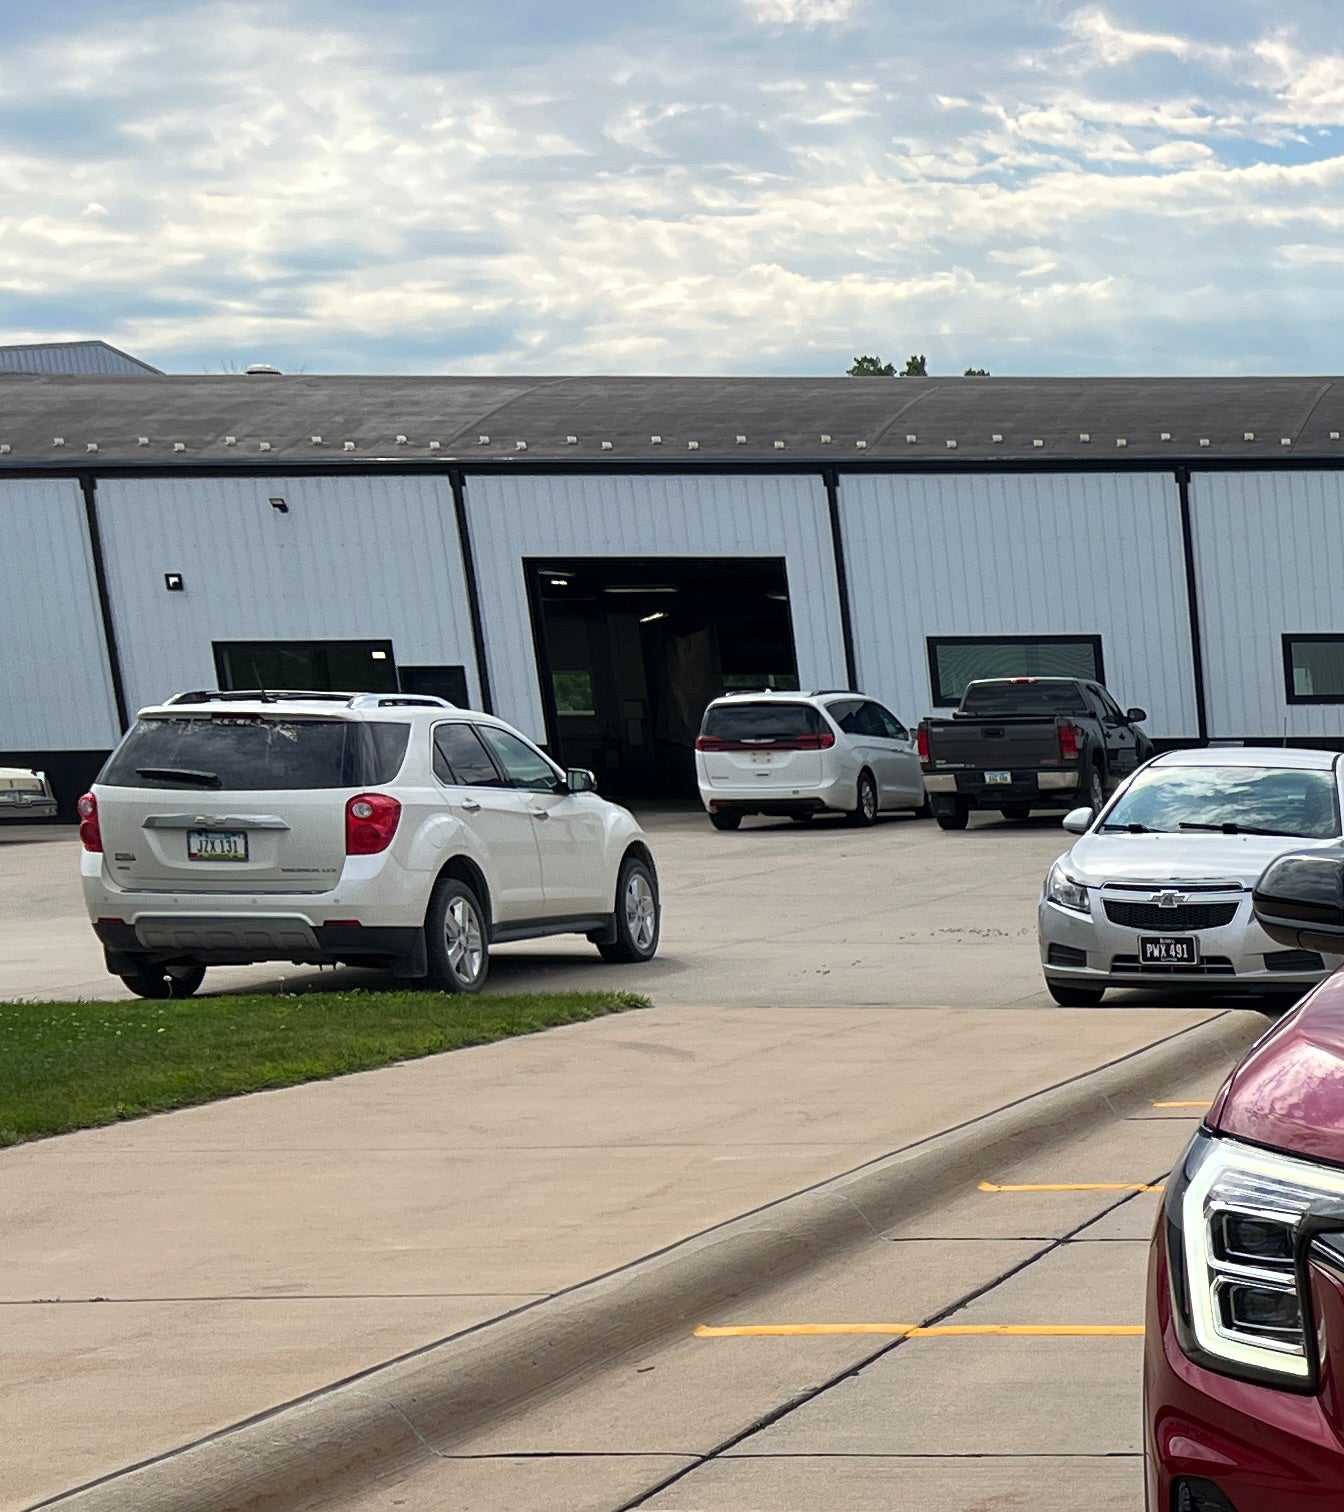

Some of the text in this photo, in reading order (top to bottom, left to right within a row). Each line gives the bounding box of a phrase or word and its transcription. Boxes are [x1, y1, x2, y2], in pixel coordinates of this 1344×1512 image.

[197, 839, 239, 854] JZX 131
[1146, 943, 1189, 958] PWX 491
